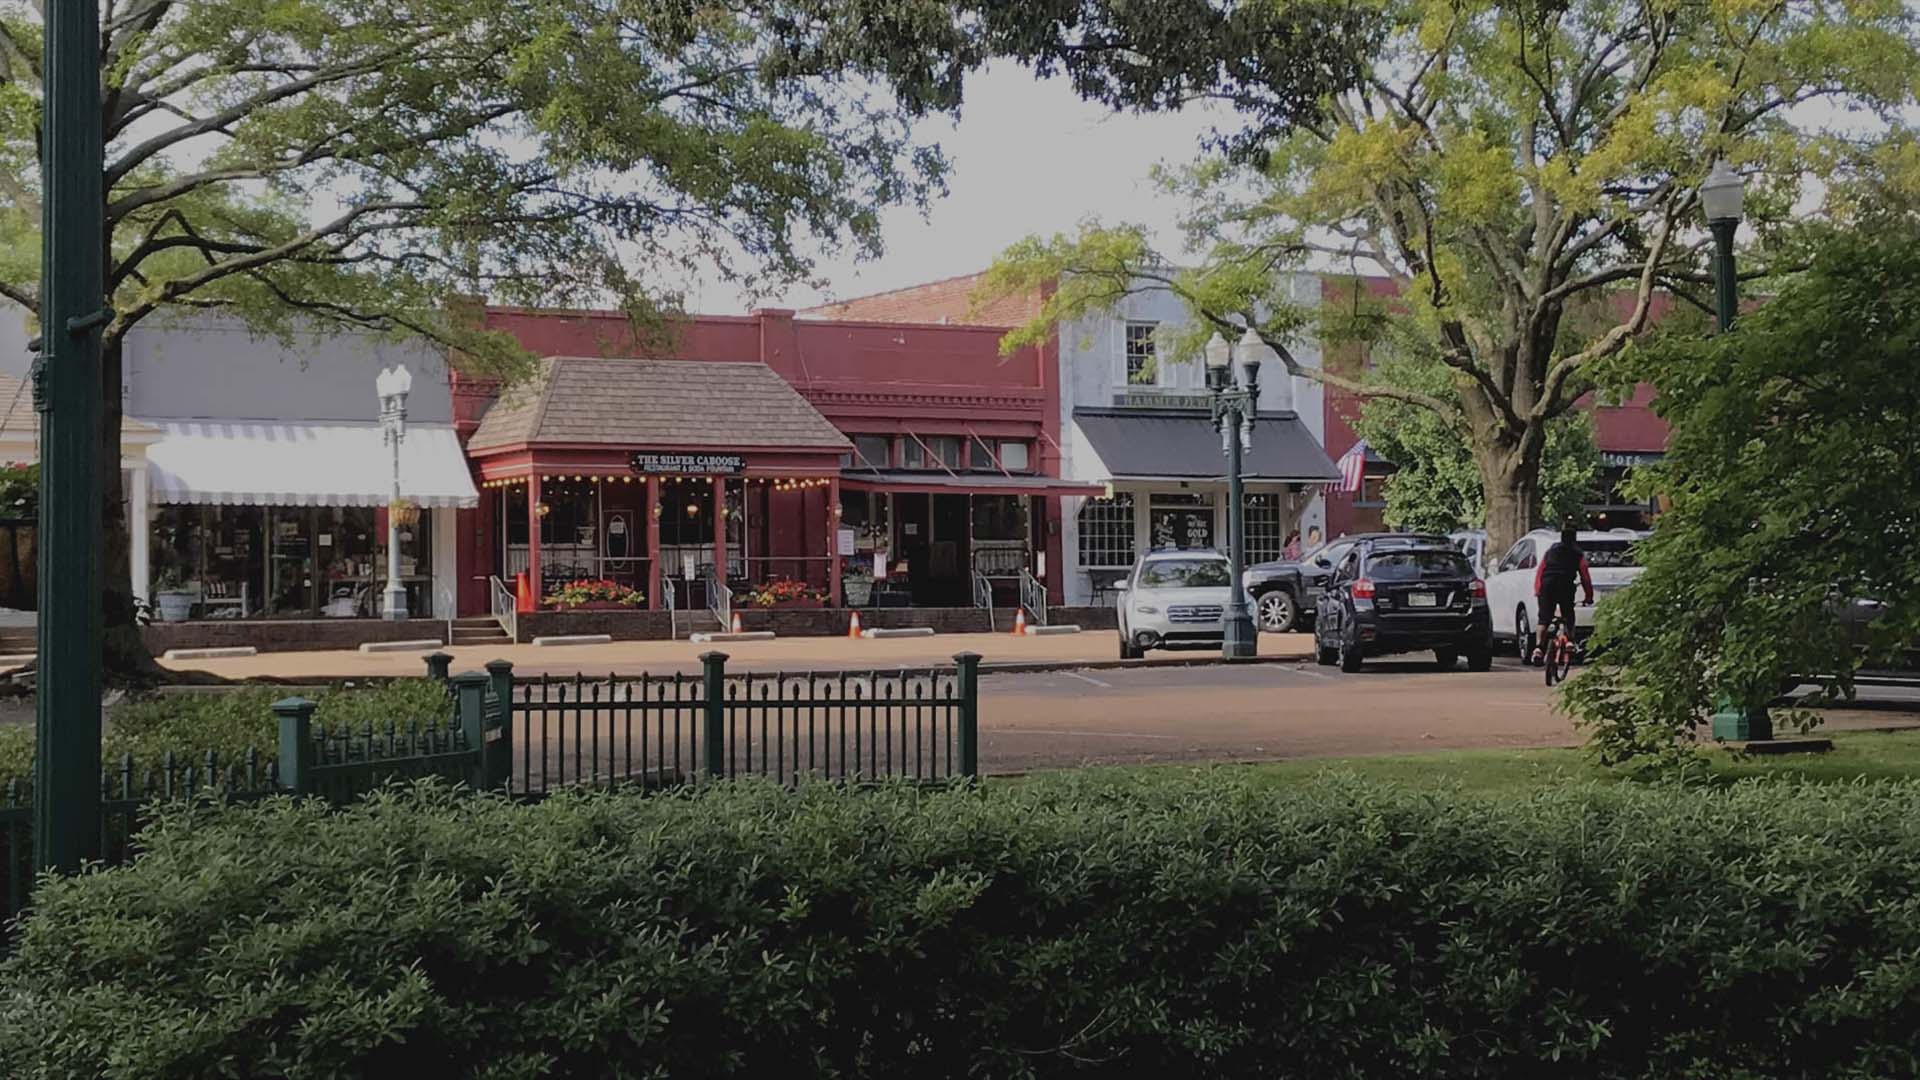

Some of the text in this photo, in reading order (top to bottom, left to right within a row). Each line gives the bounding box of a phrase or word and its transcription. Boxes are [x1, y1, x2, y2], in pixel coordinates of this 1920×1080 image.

[638, 455, 740, 466] THE SILVER CABOOSE
[1187, 528, 1208, 538] GOLD
